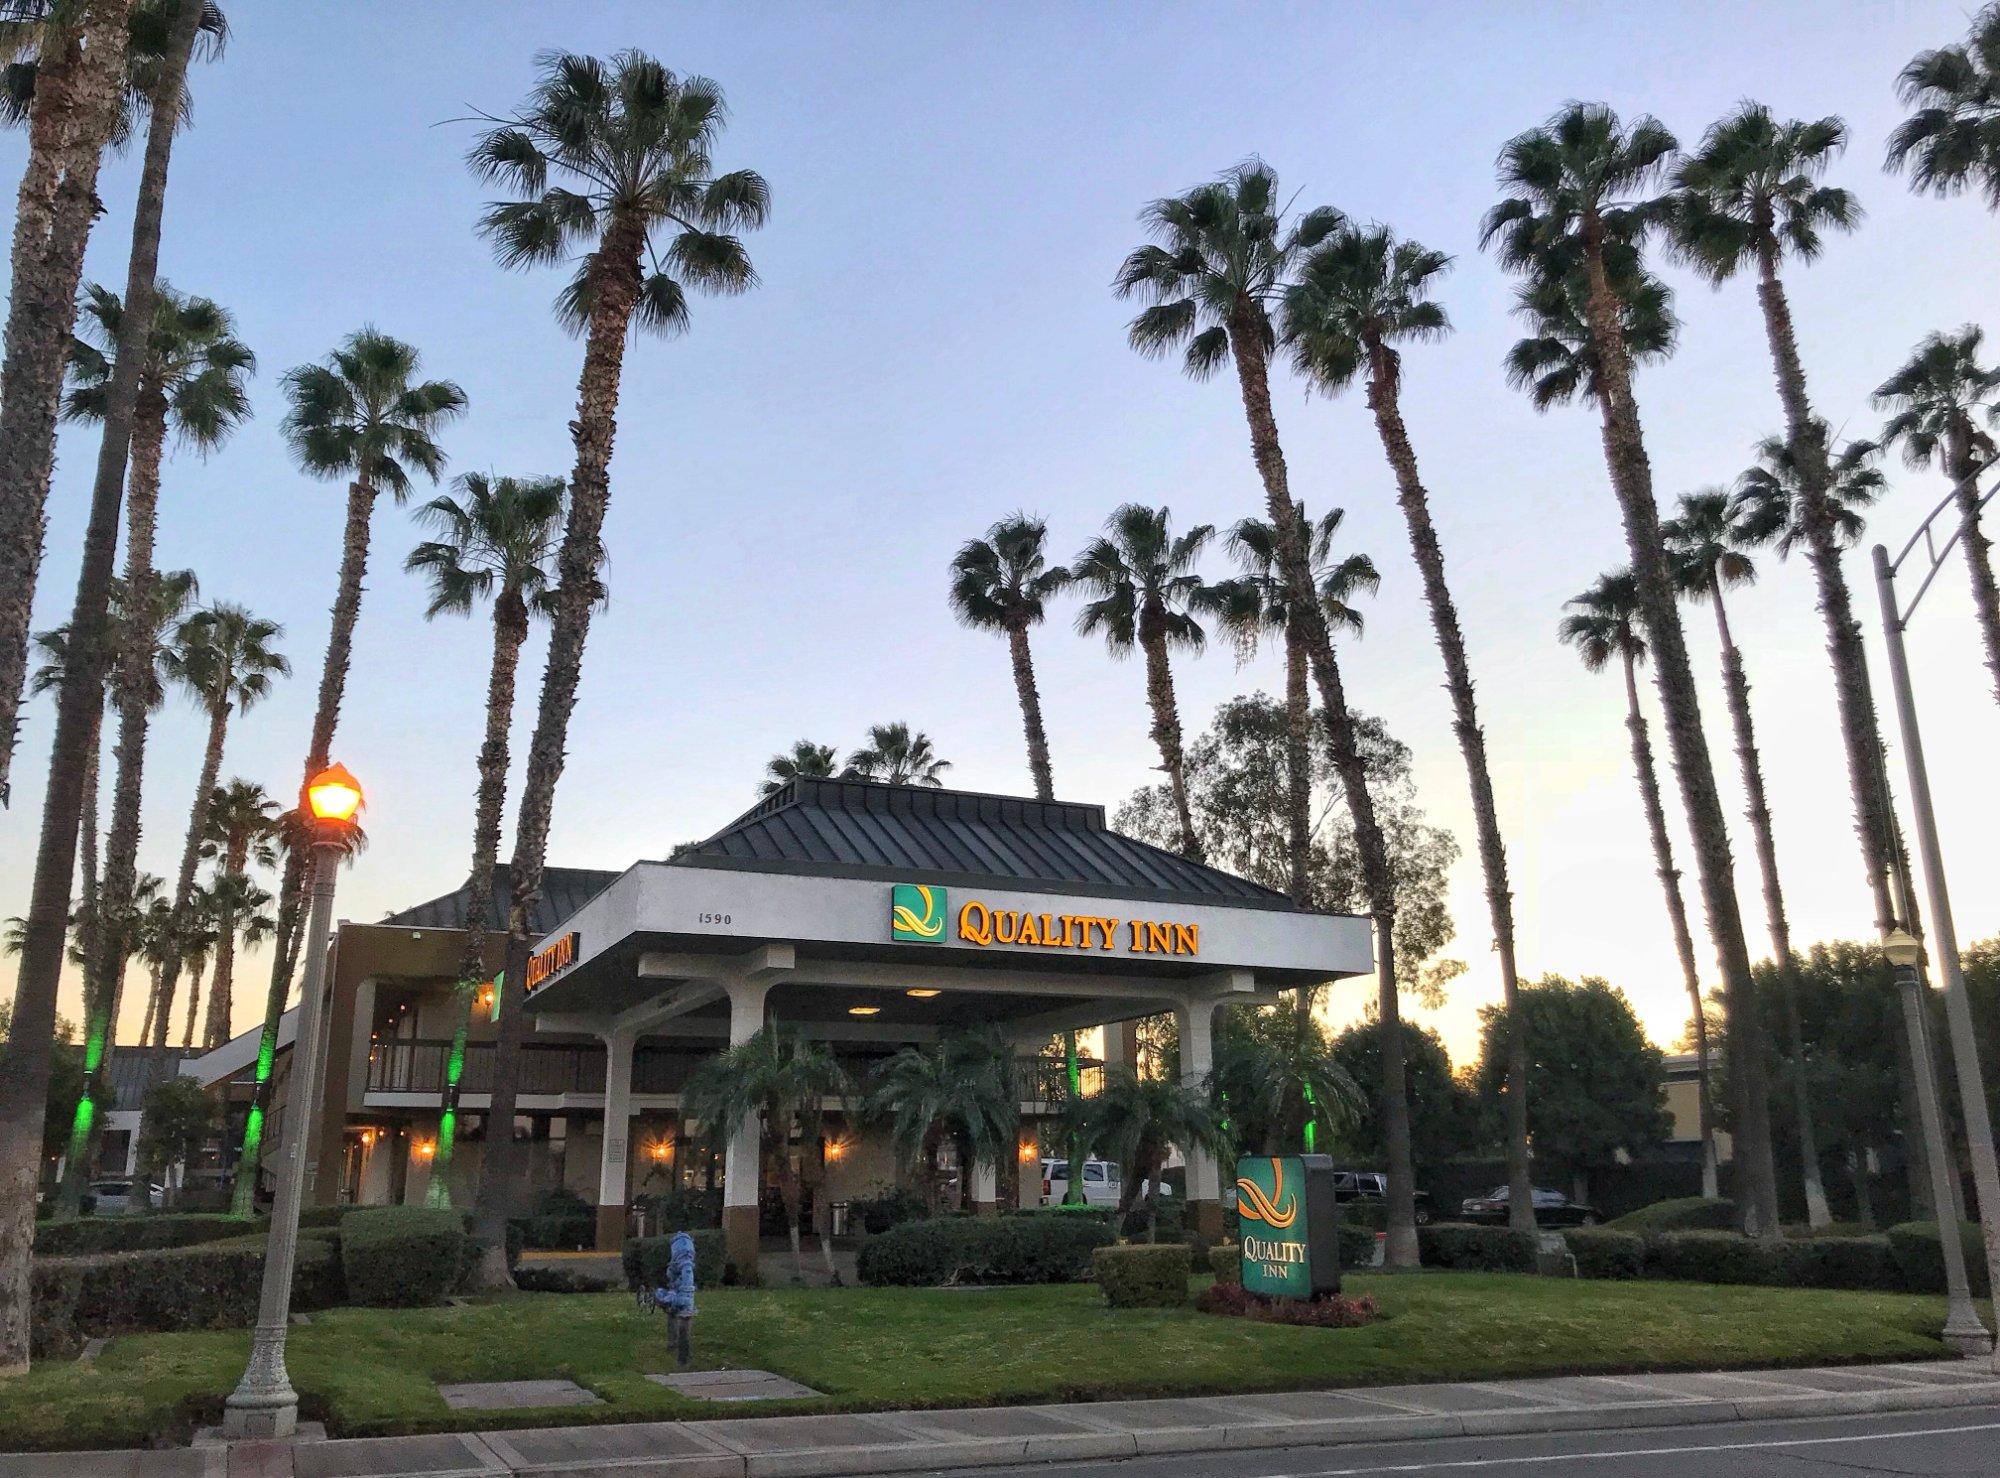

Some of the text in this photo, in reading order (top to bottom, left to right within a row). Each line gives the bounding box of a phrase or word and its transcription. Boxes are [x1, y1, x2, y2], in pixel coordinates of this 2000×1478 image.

[699, 912, 732, 925] 1590
[959, 901, 1198, 954] QUALITY INN
[1244, 1235, 1306, 1263] QUALITY
[1262, 1264, 1288, 1279] INN
